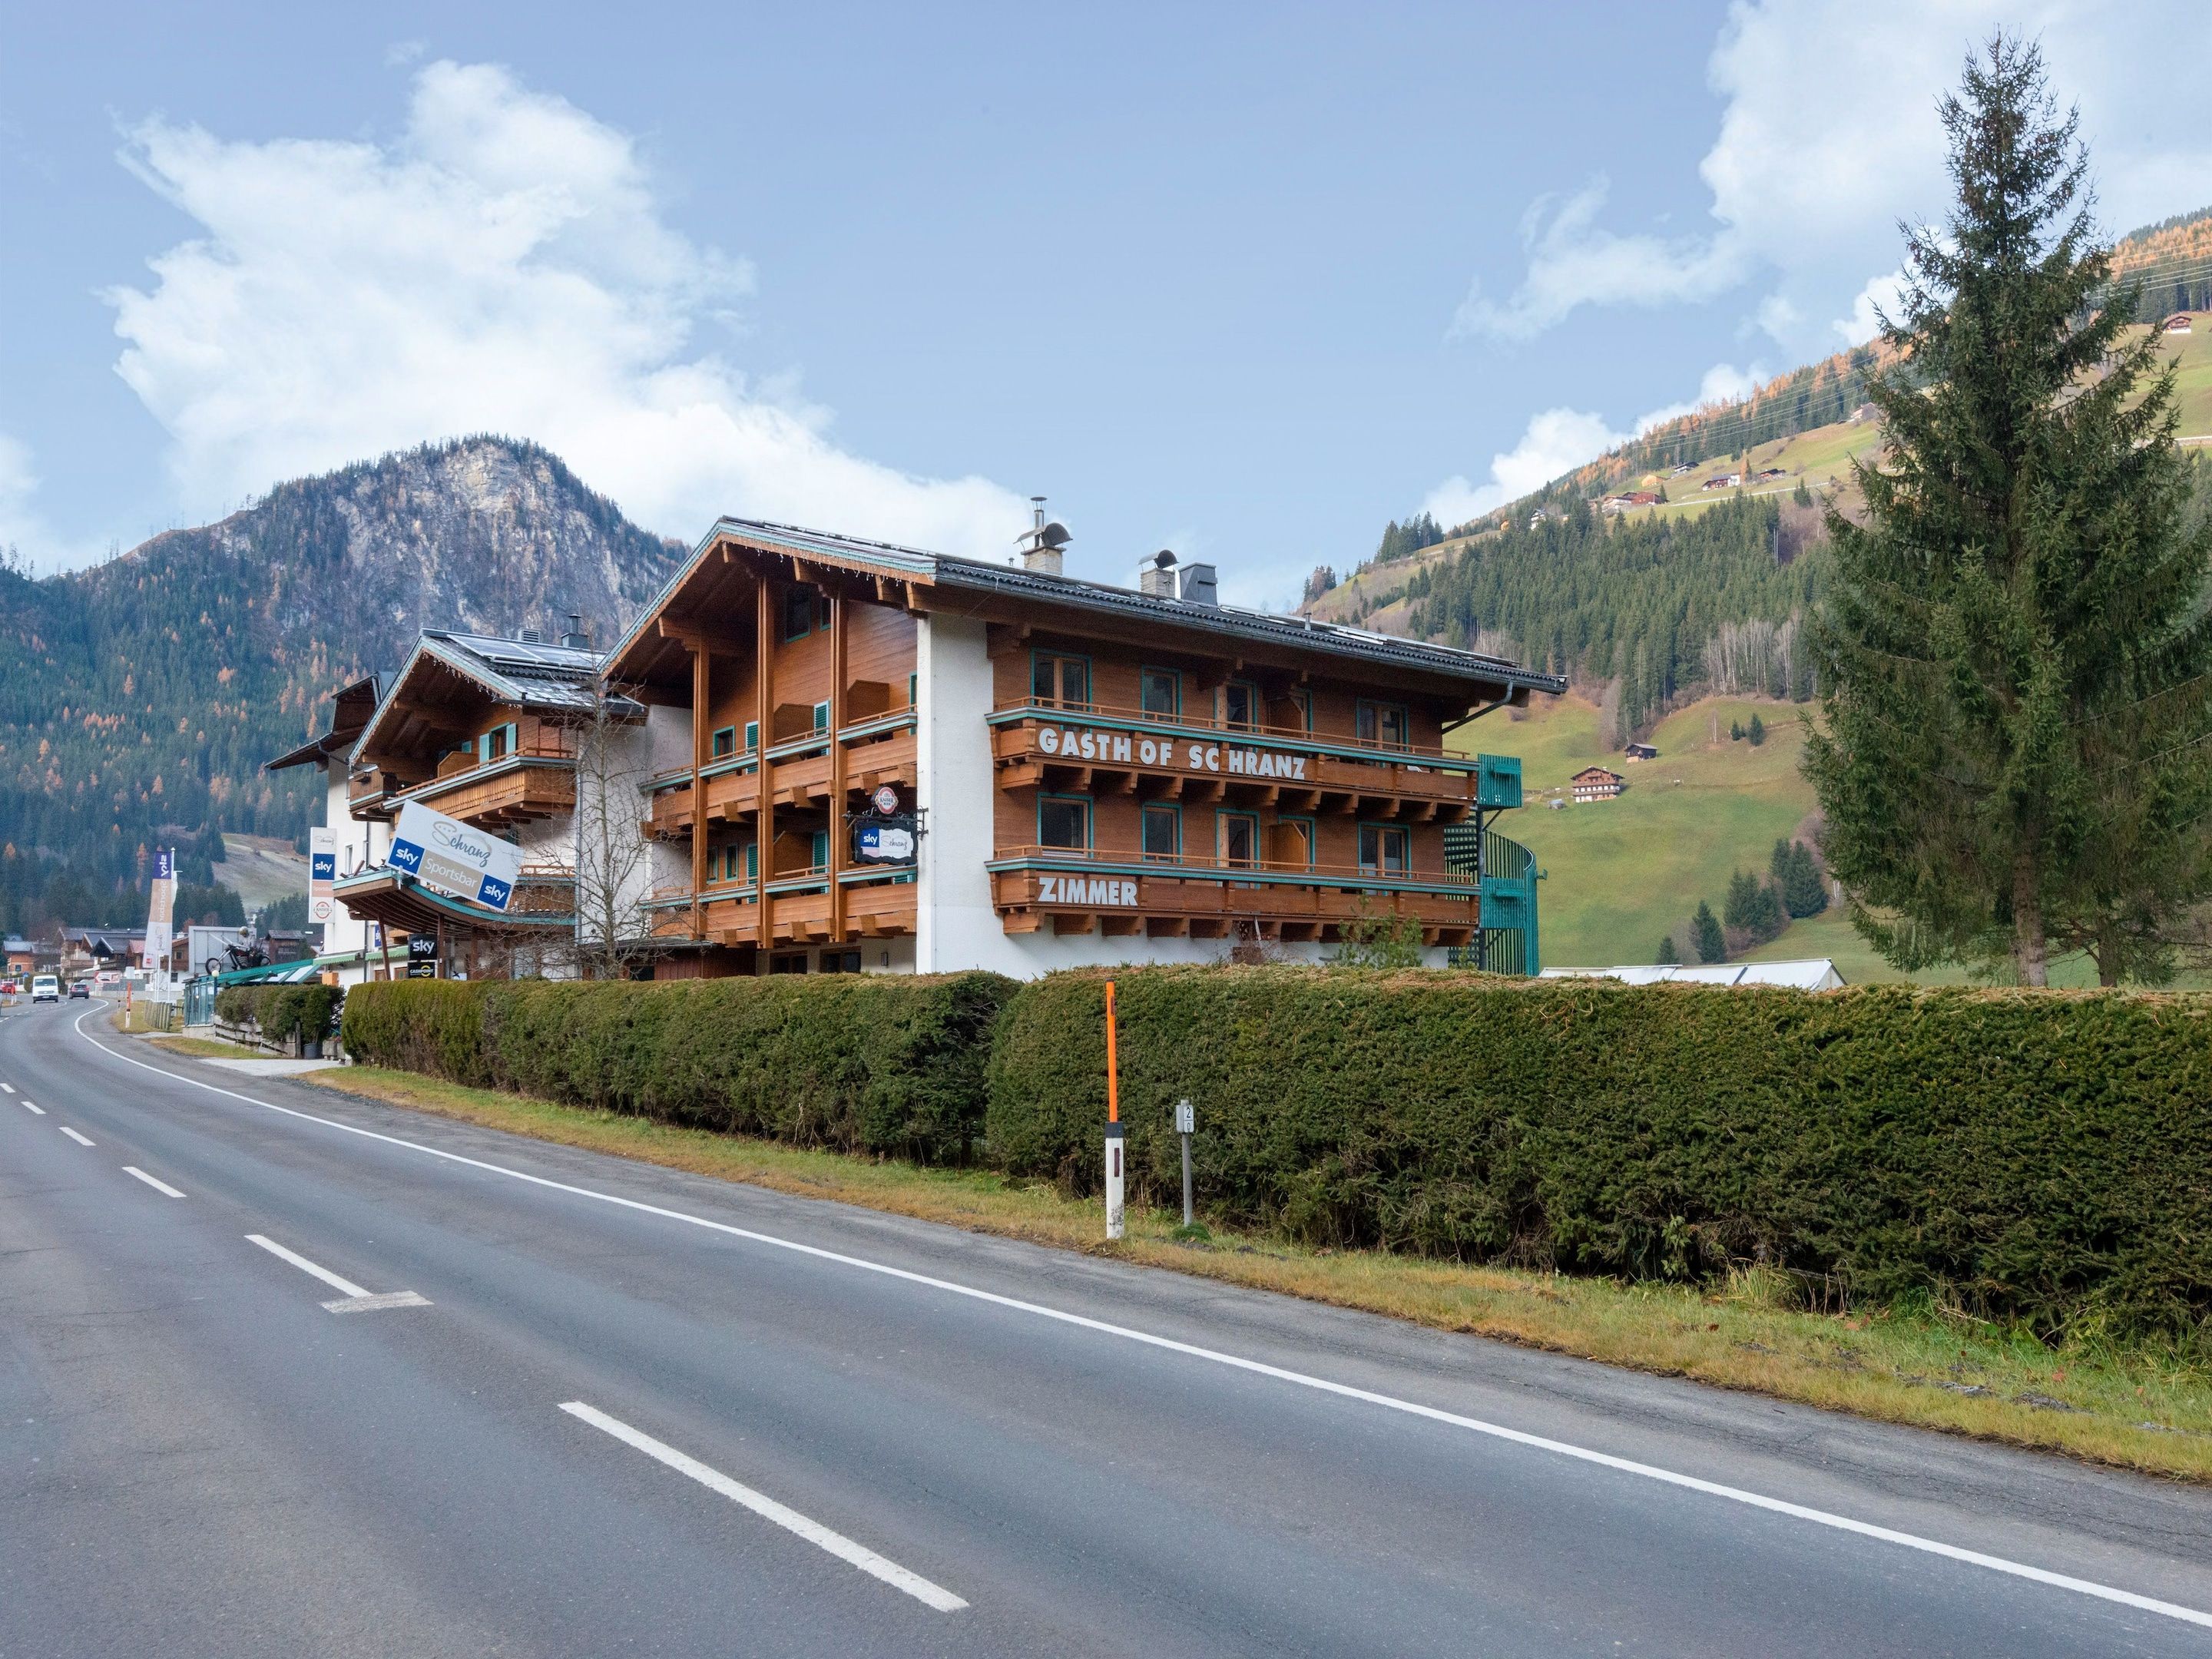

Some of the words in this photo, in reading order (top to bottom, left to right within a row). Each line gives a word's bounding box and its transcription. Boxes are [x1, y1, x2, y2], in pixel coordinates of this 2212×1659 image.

[432, 821, 492, 868] Schranz
[863, 833, 878, 845] sky
[315, 861, 333, 873] sky
[396, 848, 419, 866] sky
[425, 858, 478, 888] Sportsbar
[485, 884, 506, 901] sky
[1038, 877, 1138, 906] ZIMMER
[412, 939, 435, 954] sky
[1186, 1107, 1190, 1118] 2
